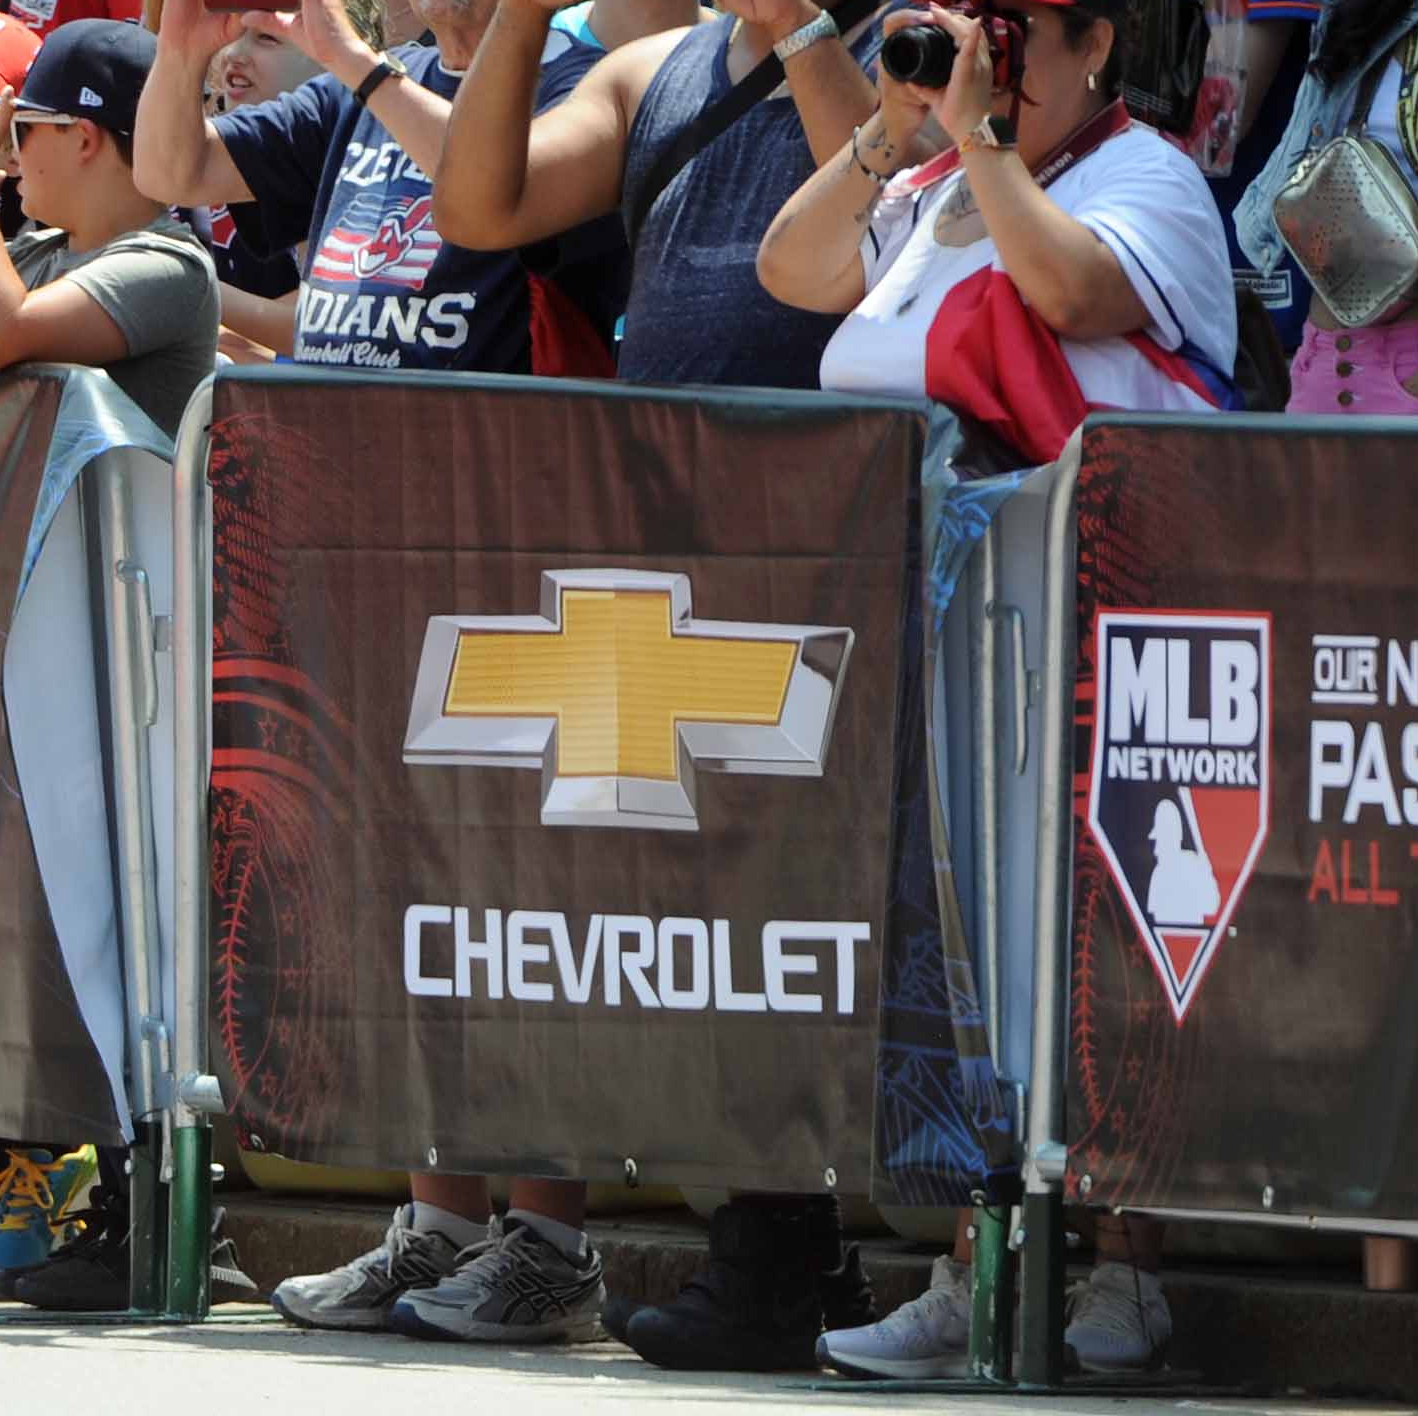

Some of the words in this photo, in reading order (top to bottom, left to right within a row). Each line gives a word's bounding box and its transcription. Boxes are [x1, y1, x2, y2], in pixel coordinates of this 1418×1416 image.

[1108, 635, 1259, 746] MLB
[1313, 647, 1377, 693] OUR
[1107, 747, 1259, 786] NETWORK
[1308, 840, 1399, 906] ALL
[403, 903, 871, 1015] CHEVROLET
